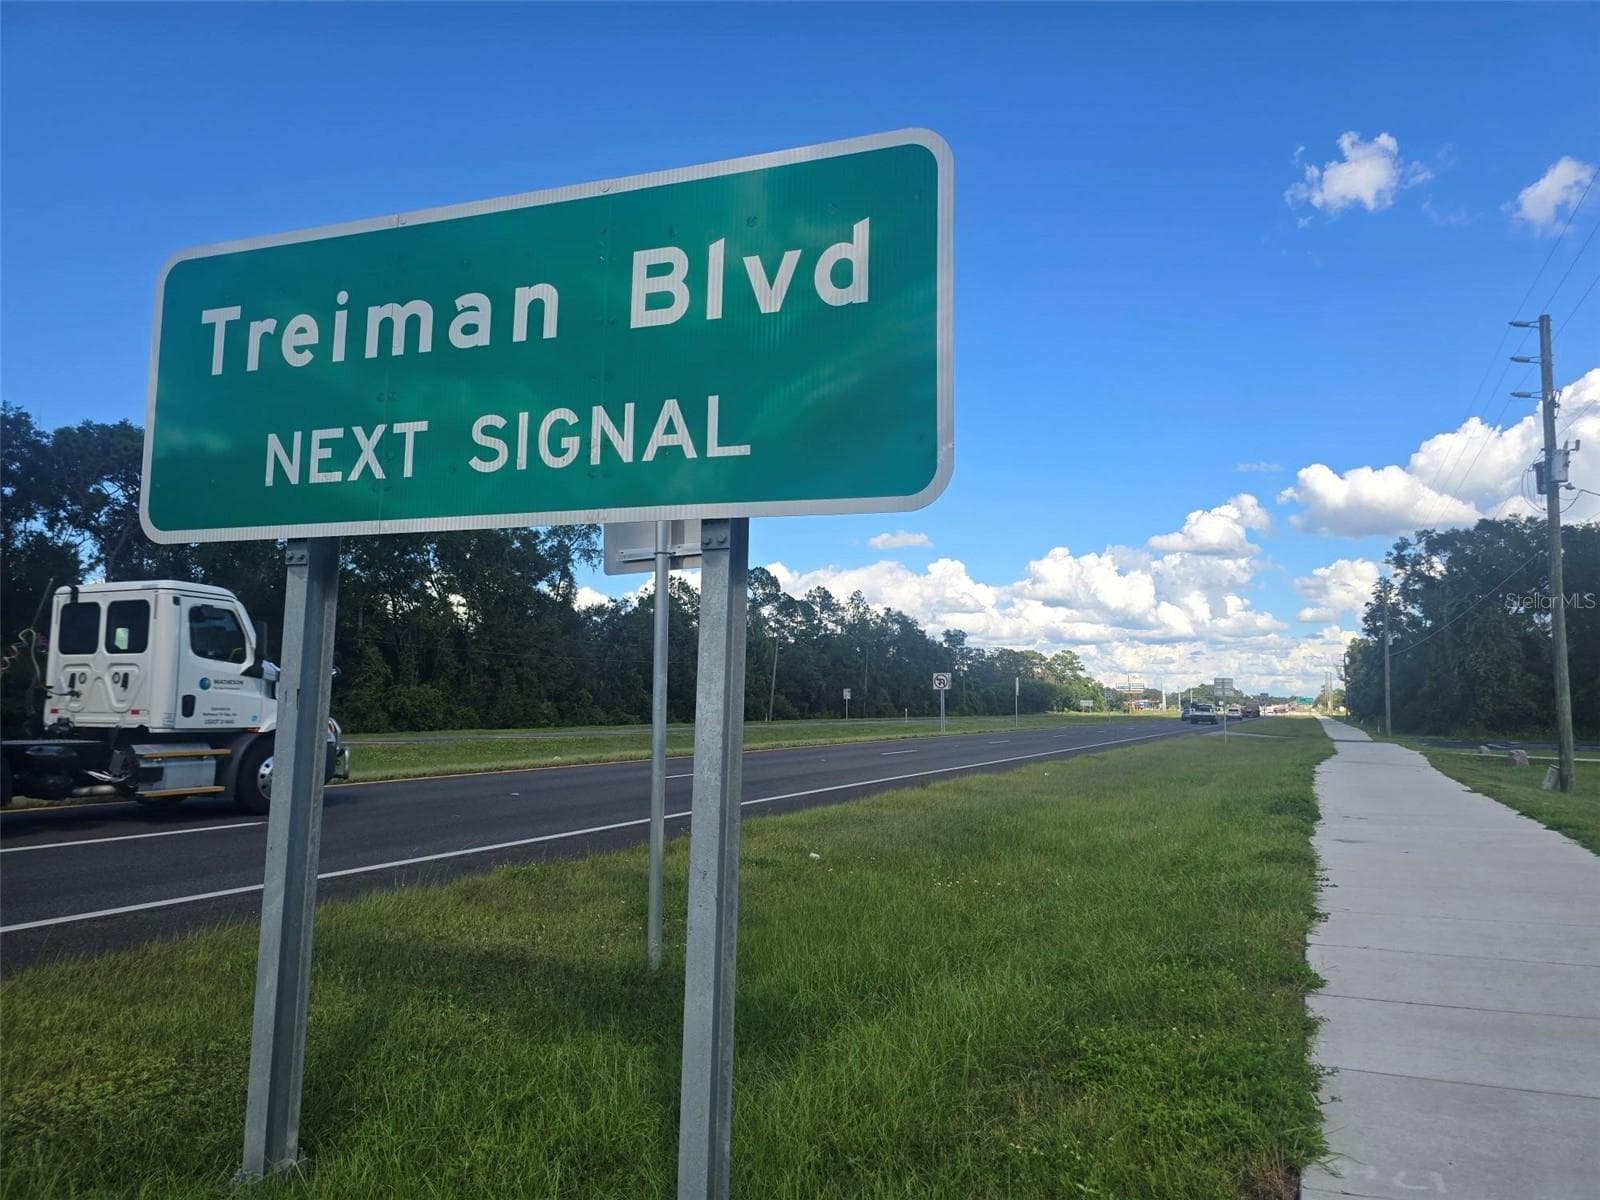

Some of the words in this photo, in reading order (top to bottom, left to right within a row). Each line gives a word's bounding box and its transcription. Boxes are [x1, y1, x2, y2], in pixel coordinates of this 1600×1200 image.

[201, 284, 559, 376] Treiman
[630, 217, 870, 329] Blvd
[265, 420, 428, 487] NEXT
[468, 396, 751, 473] SIGNAL
